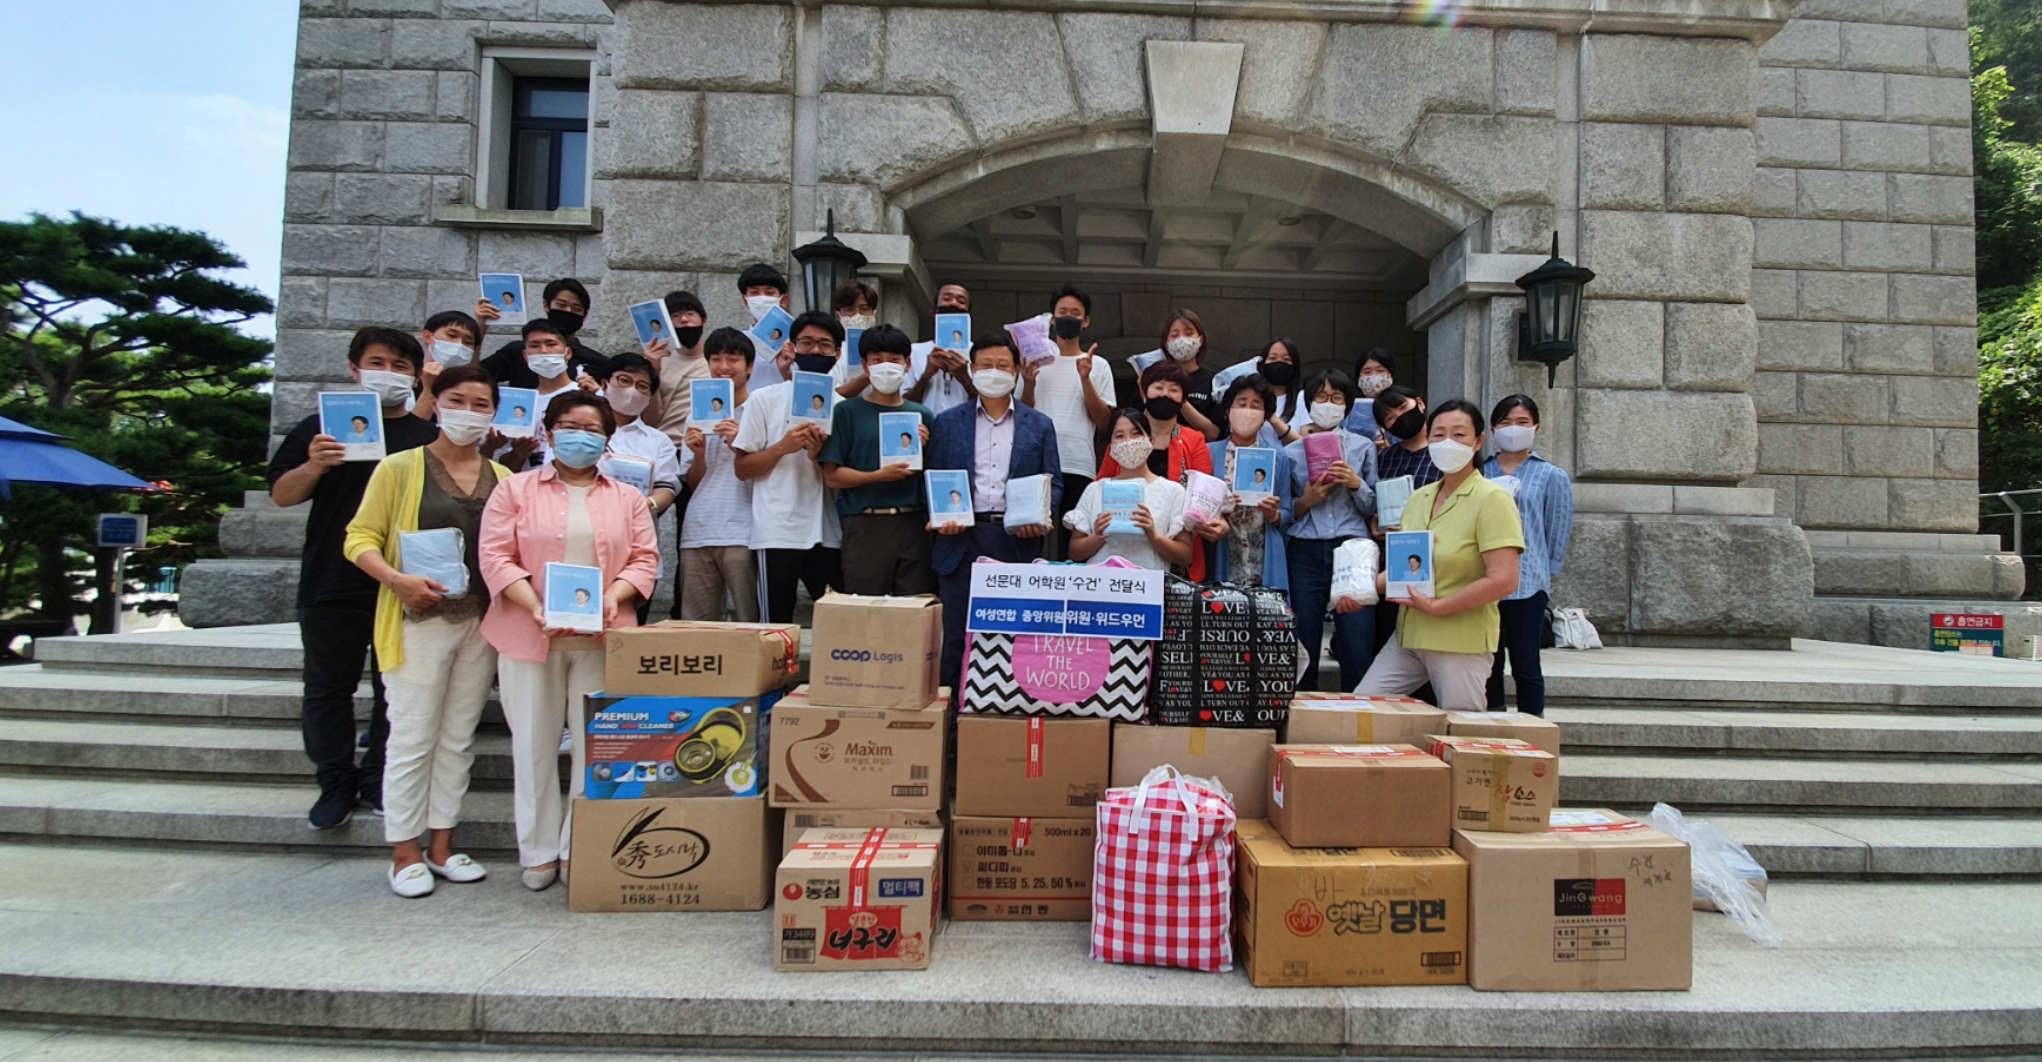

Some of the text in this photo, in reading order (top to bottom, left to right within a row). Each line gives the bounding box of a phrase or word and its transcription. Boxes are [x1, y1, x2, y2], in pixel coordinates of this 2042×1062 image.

[985, 574, 1022, 588] 선문대
[1028, 576, 1065, 590] 어학원
[1109, 579, 1146, 594] 전달식
[975, 609, 1017, 622] 여성연합
[1957, 616, 1993, 627] 흡연금지
[637, 654, 722, 675] 보리보리
[873, 652, 904, 664] Logis
[1047, 655, 1073, 670] THE
[1026, 666, 1091, 690] WORLD
[1260, 681, 1294, 692] YOU
[594, 712, 649, 721] PREMIUM
[779, 717, 800, 726] 7792
[844, 740, 893, 757] Maxim
[843, 757, 893, 766] 모카골드 마일드
[1045, 827, 1072, 837] 500ml
[1080, 827, 1091, 837] 20
[883, 881, 920, 896] 멀티팩
[995, 877, 1017, 889] 포도당
[806, 885, 840, 900] 농심
[621, 894, 700, 905] 1688-4124
[1326, 899, 1446, 936] 옛날 당면
[829, 927, 897, 951] 너구리
